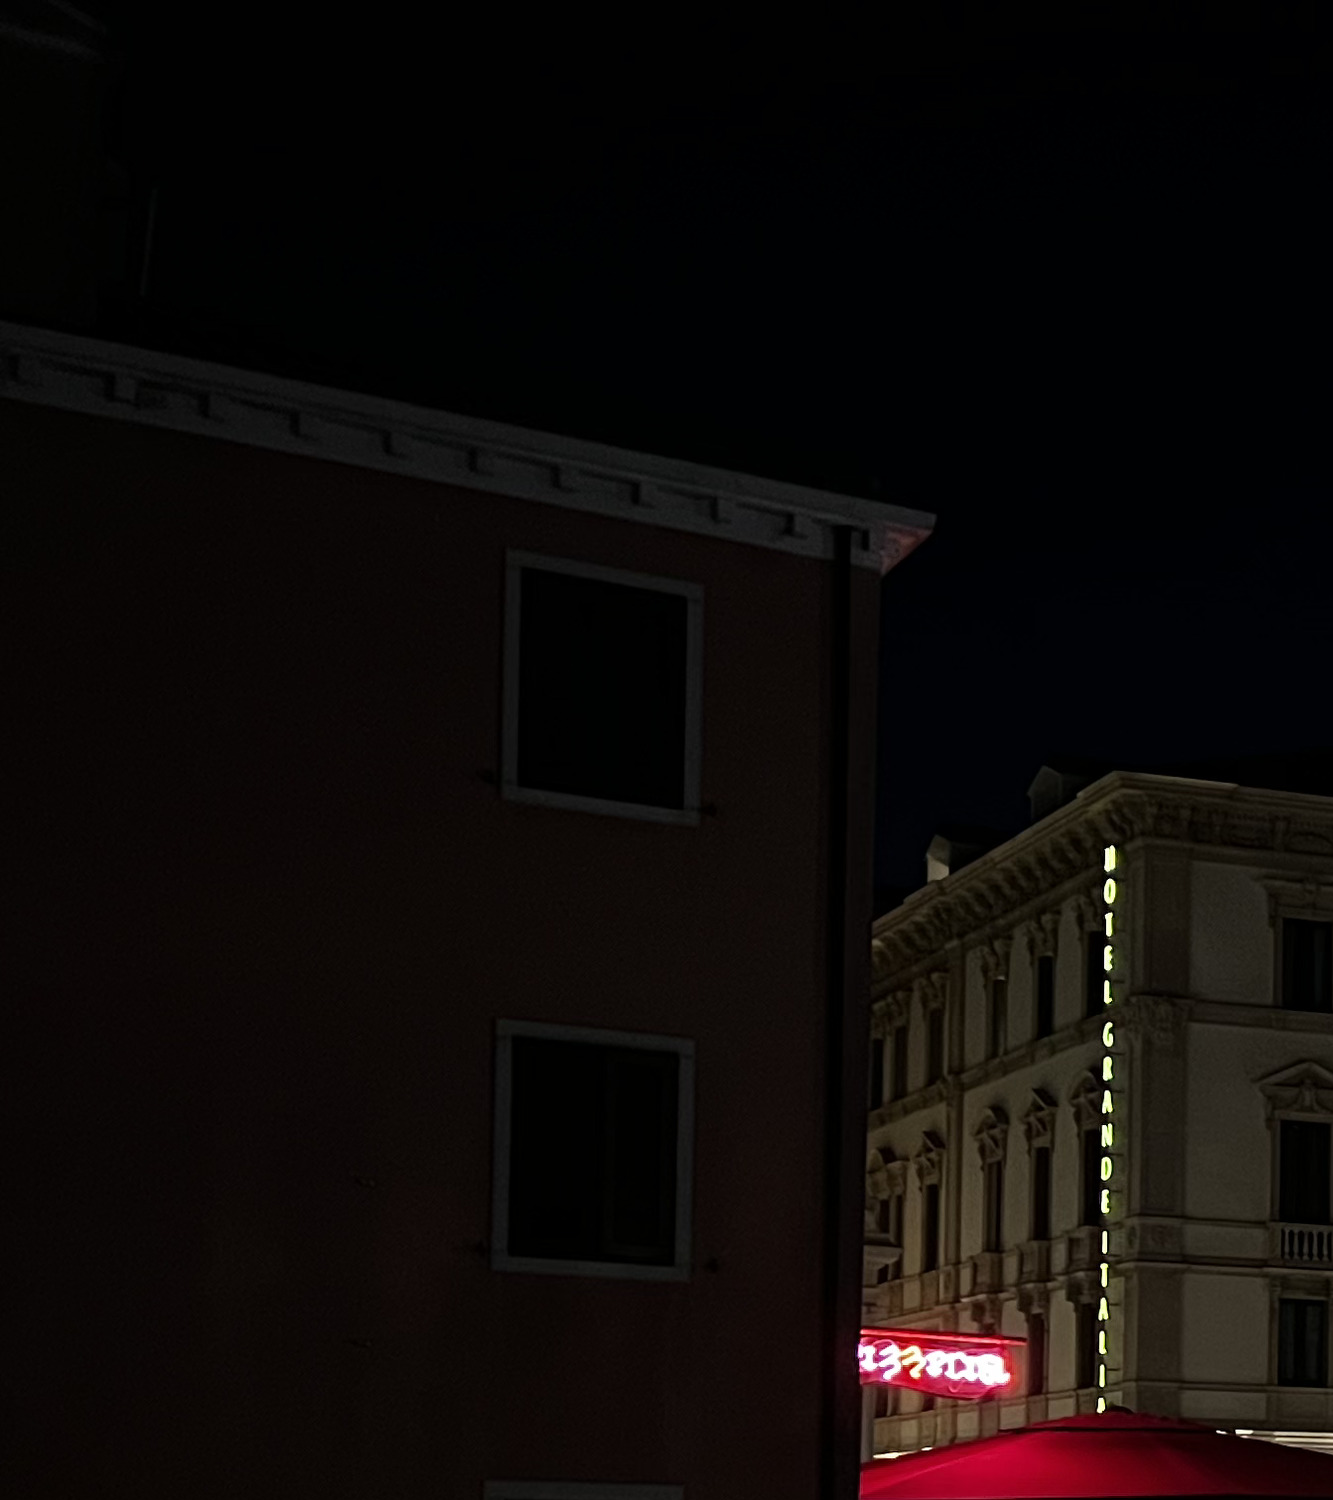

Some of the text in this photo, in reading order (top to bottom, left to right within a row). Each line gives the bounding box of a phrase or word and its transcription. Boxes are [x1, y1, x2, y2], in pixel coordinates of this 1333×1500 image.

[1097, 844, 1117, 1414] HOTEL GRANDE ITALIA
